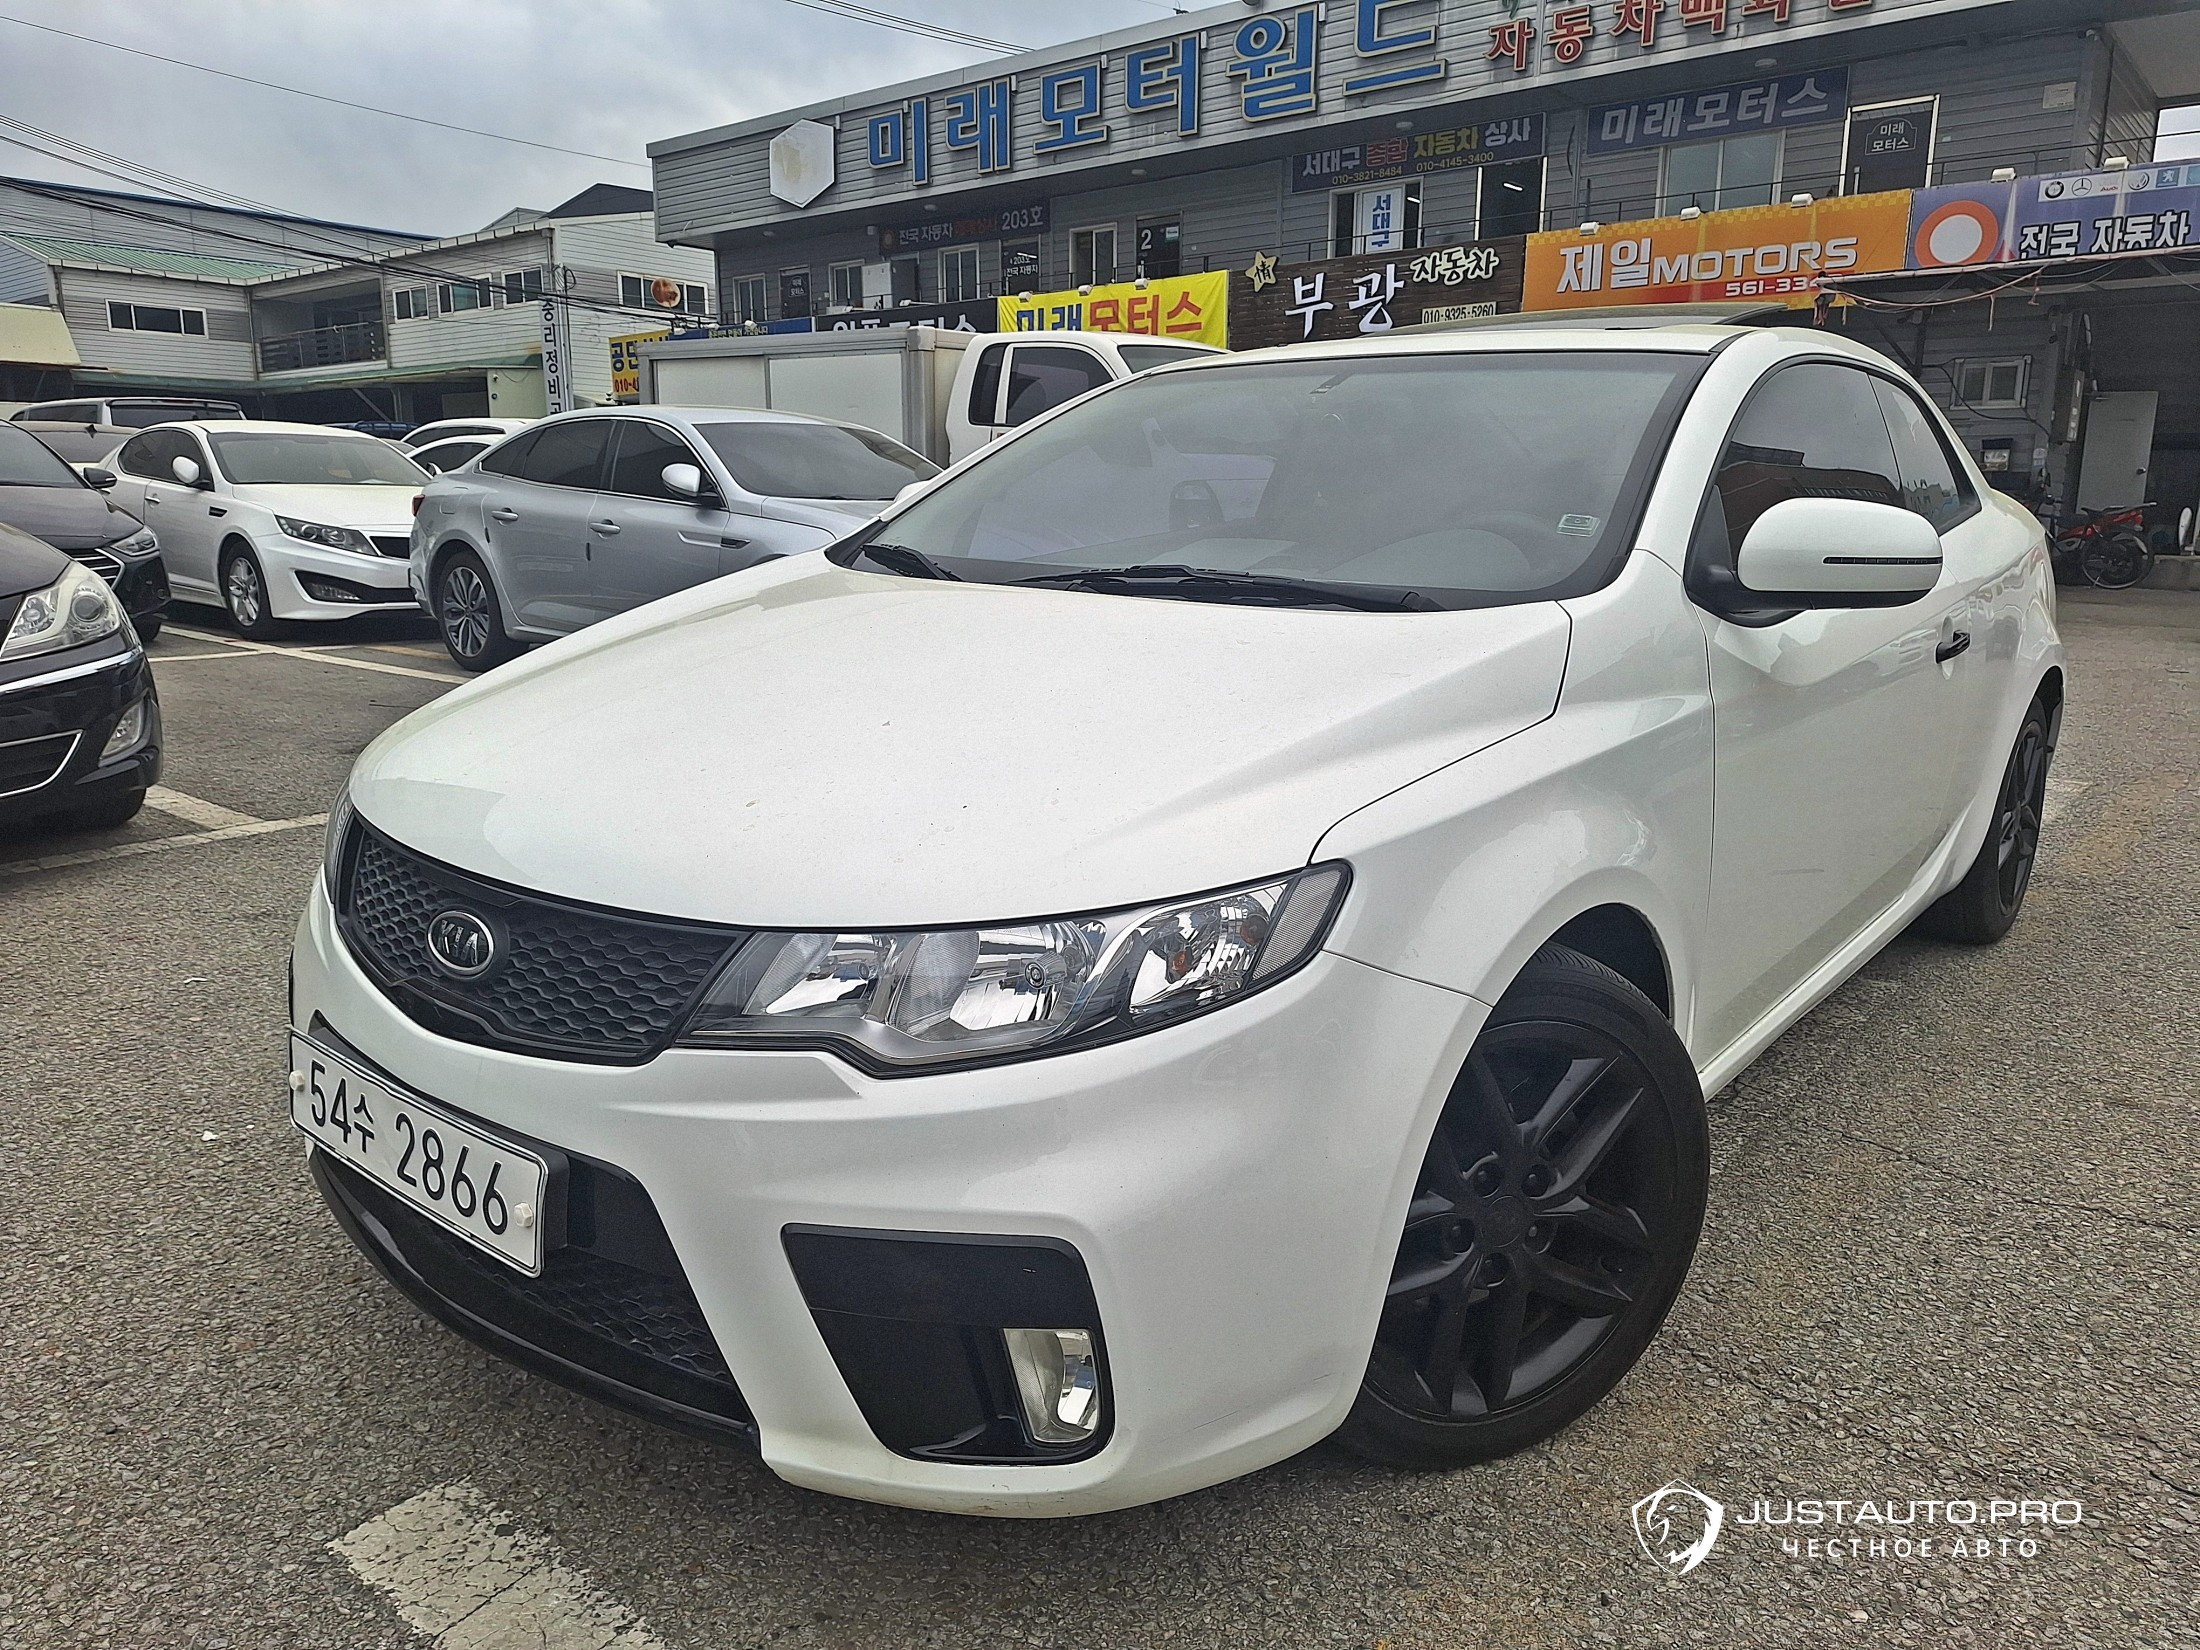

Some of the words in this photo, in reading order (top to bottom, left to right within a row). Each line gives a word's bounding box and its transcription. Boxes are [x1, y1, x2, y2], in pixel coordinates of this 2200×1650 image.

[1601, 77, 1829, 144] 미래모터스
[1880, 122, 1905, 136] 미래
[1303, 146, 1361, 177] 서대구
[1414, 126, 1480, 158] 자동차
[1485, 118, 1531, 147] 상사
[1416, 152, 1495, 172] 010-4145-3400
[1872, 137, 1909, 151] 모터스
[1002, 206, 1043, 231] 203호
[1371, 194, 1391, 247] 서대구
[2020, 220, 2081, 259] 전국
[2090, 210, 2191, 253] 자동차
[1410, 247, 1499, 285] 자동차
[439, 919, 480, 966] KIA
[310, 1058, 376, 1154] 54수
[395, 1112, 509, 1237] 2866
